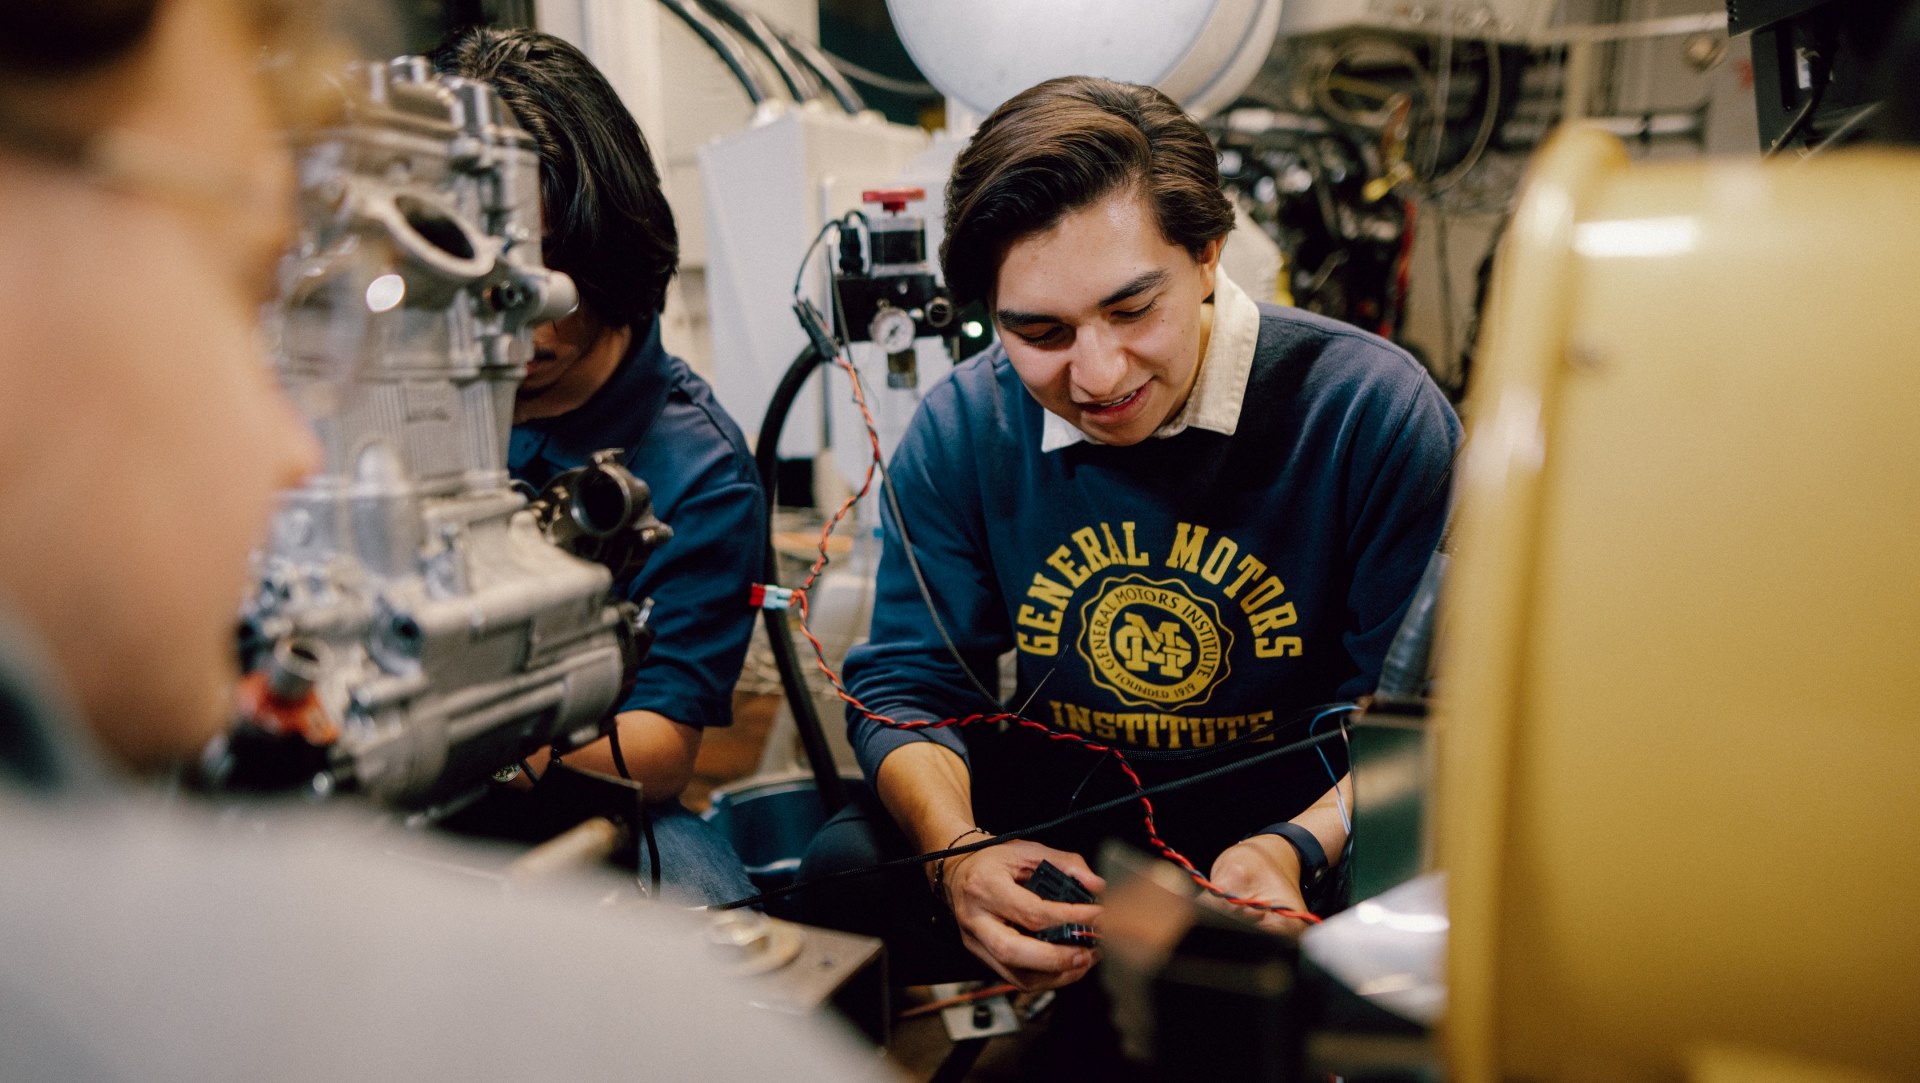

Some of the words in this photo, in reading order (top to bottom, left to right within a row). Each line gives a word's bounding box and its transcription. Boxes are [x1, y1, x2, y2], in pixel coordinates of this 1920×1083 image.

[1016, 521, 1149, 656] GENERAL
[1165, 522, 1303, 659] MOTORS
[1092, 602, 1117, 671] GENERAL
[1114, 587, 1180, 609] MOTORS
[1181, 604, 1218, 680] INSTITUTE
[1114, 672, 1170, 699] FOUNDED
[1173, 682, 1196, 698] 1919
[1049, 700, 1274, 749] INSTITUTE
